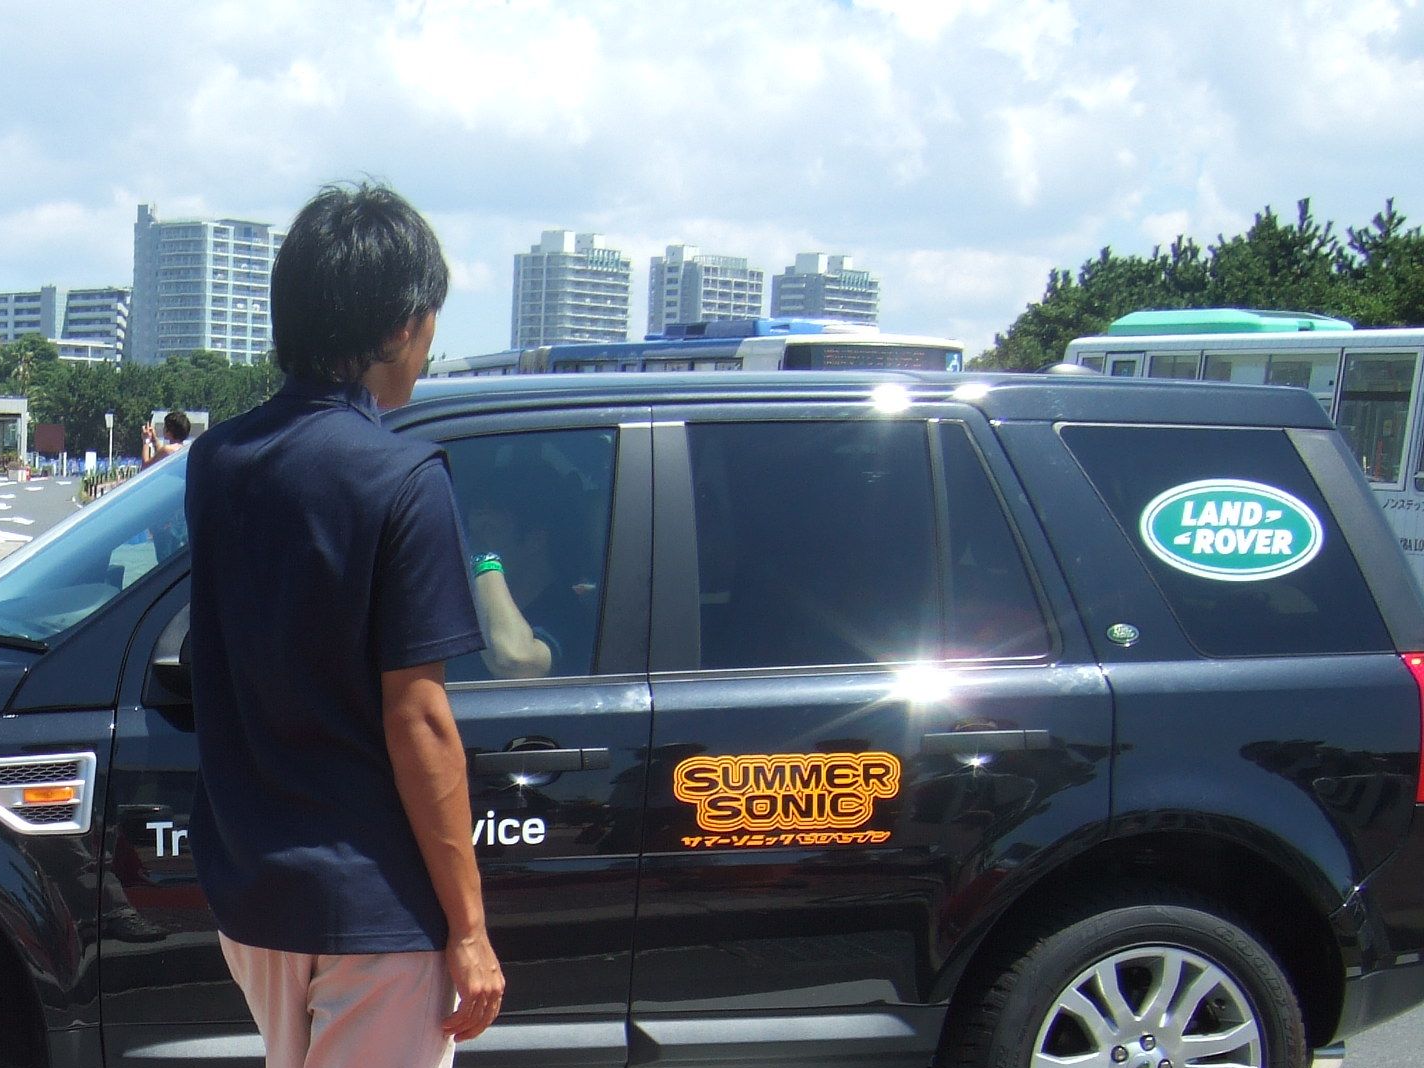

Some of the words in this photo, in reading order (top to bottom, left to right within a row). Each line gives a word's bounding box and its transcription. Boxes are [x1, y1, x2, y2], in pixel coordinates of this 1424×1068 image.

[1382, 498, 1424, 512] ノンステッ
[679, 758, 896, 795] SUMMER
[702, 791, 868, 825] SONIC
[472, 810, 546, 846] vice
